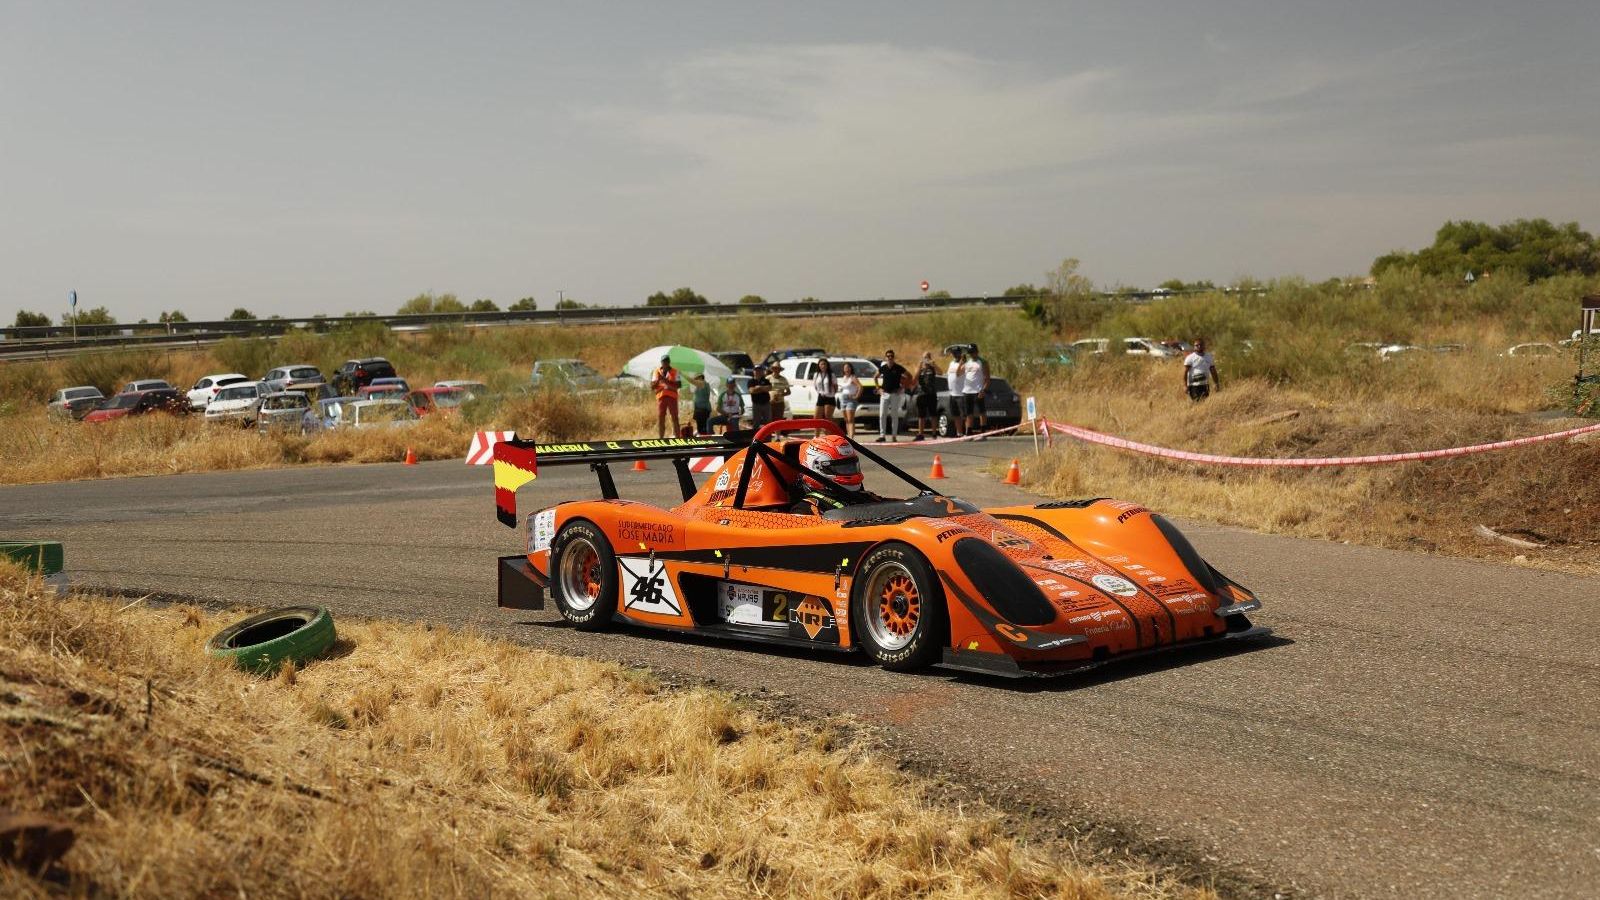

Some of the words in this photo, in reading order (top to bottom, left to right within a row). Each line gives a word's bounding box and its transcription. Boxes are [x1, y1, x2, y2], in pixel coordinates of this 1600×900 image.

[606, 441, 624, 450] EL
[618, 520, 674, 532] SUPERMERCADO
[630, 576, 665, 605] 46
[772, 593, 787, 621] 2
